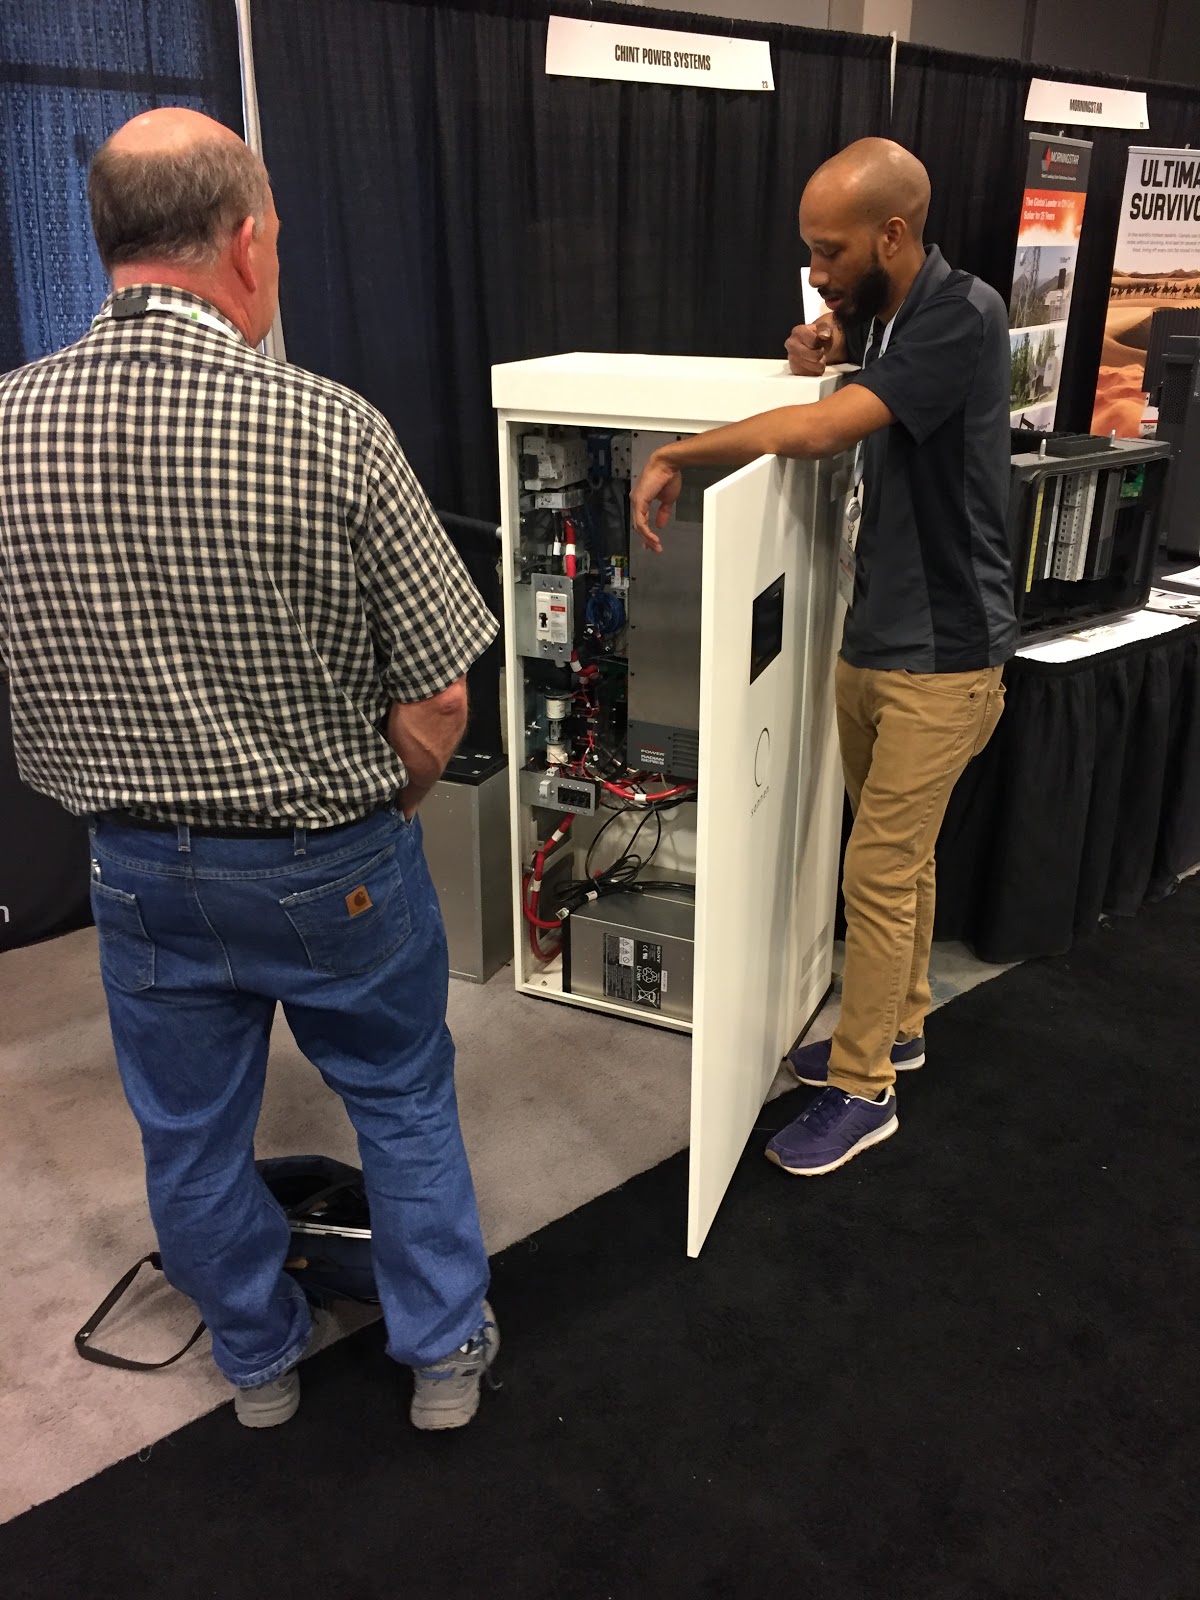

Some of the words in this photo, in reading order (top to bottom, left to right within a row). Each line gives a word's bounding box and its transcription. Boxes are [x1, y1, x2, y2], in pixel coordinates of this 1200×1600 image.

[614, 44, 640, 63] CHINT
[642, 47, 672, 67] POWER
[673, 51, 711, 71] SYSTEMS
[1069, 98, 1103, 115] MORNINGSTAR
[1051, 151, 1080, 165] MORNINGSTAR
